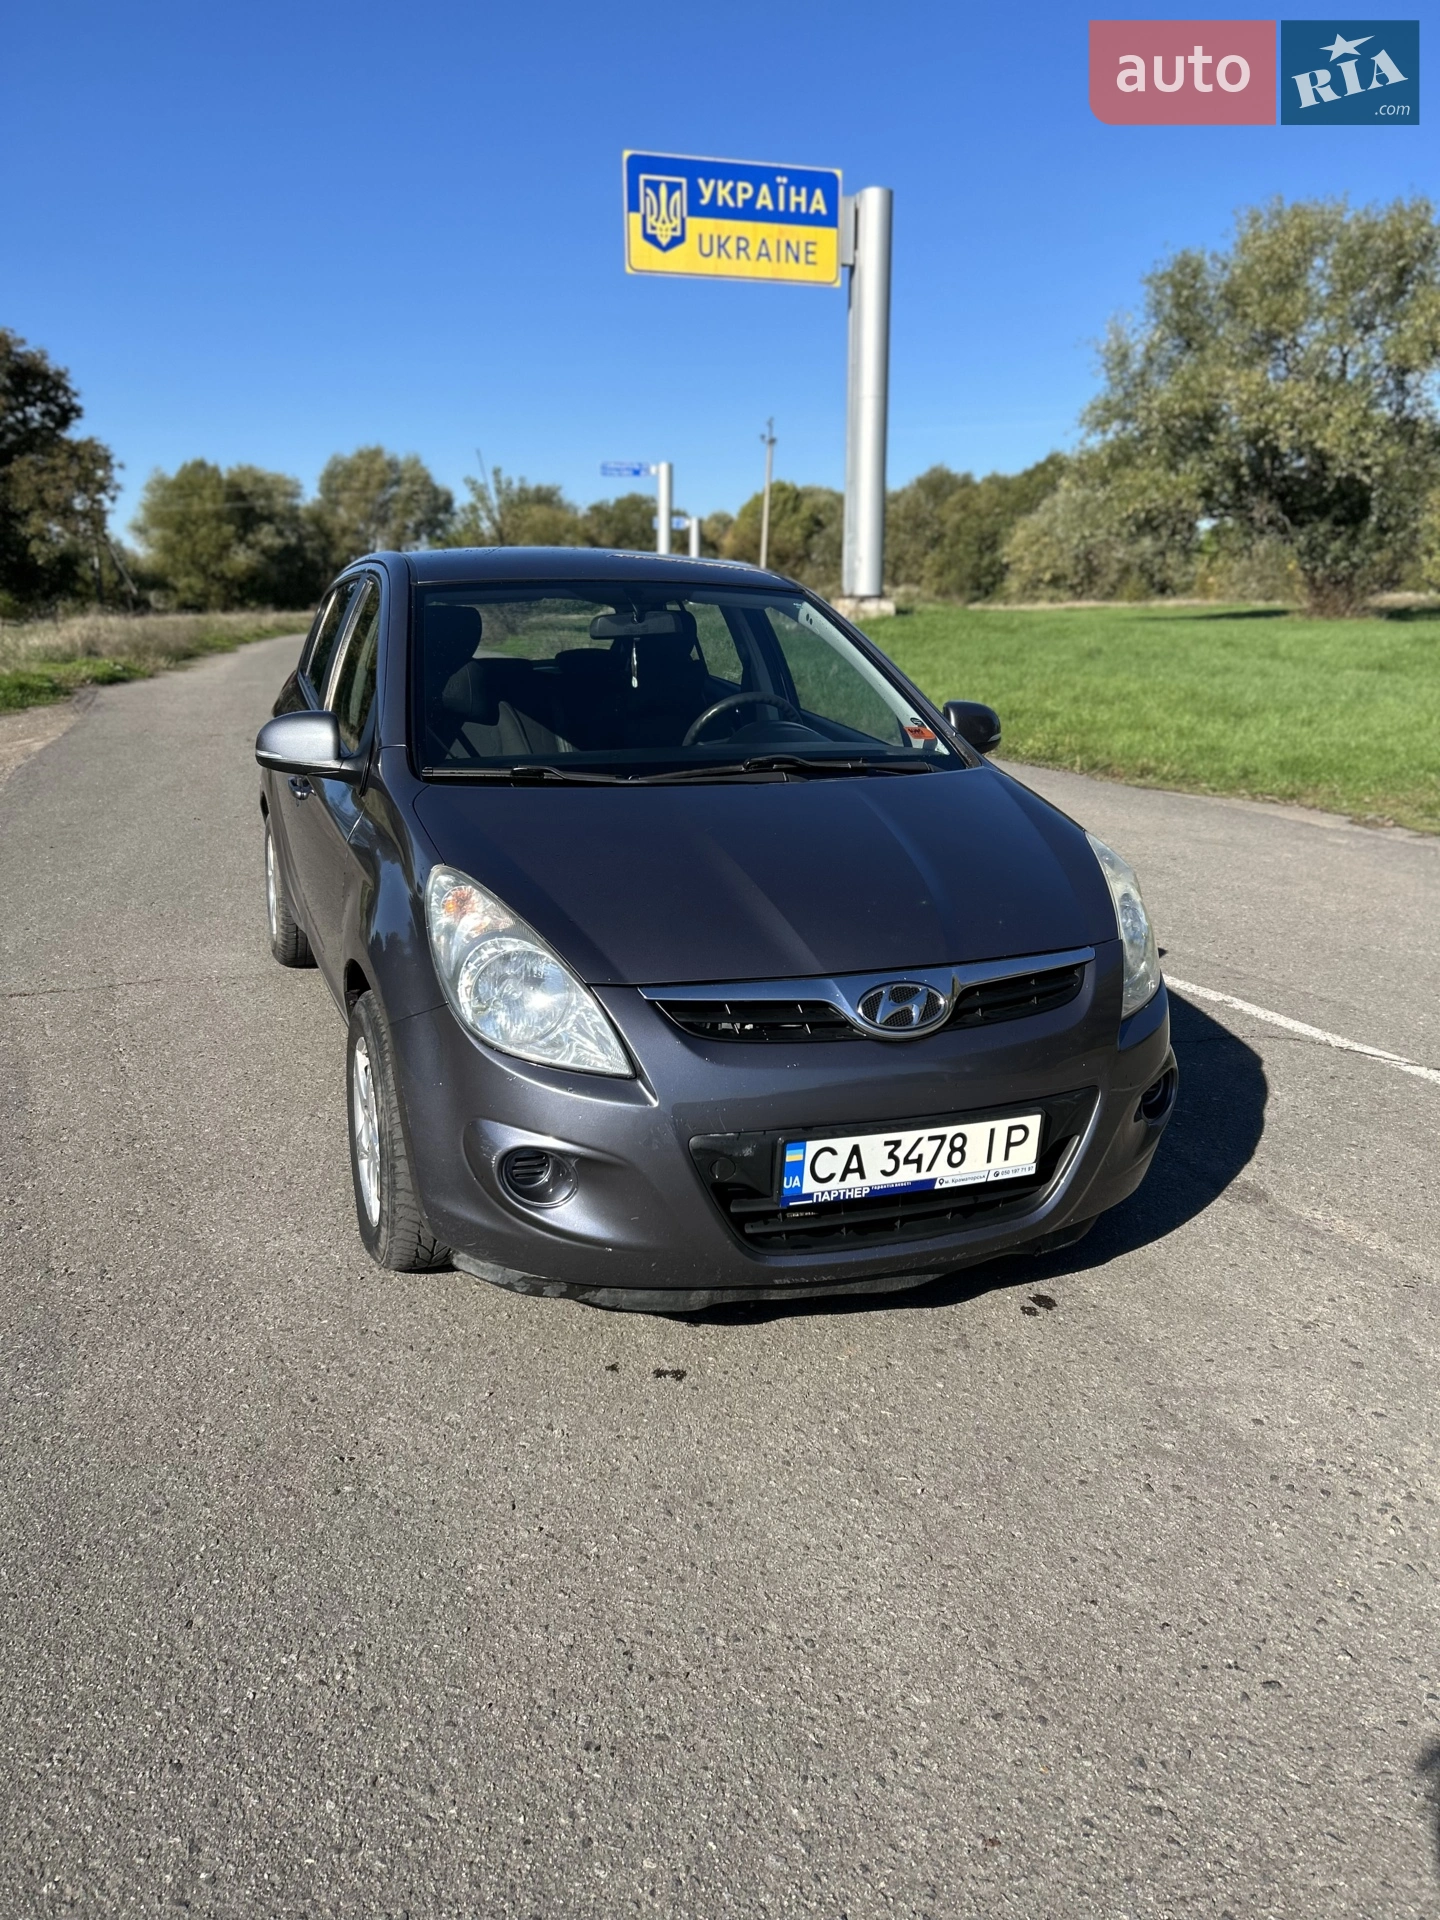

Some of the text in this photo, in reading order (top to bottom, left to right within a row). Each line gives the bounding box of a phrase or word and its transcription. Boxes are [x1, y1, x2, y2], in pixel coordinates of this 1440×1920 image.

[697, 176, 828, 216] УКРАЇНА
[698, 232, 818, 266] UKRAINE
[879, 1132, 968, 1178] 3478
[783, 1176, 801, 1189] UA
[813, 1187, 871, 1203] ПАРТНЕР
